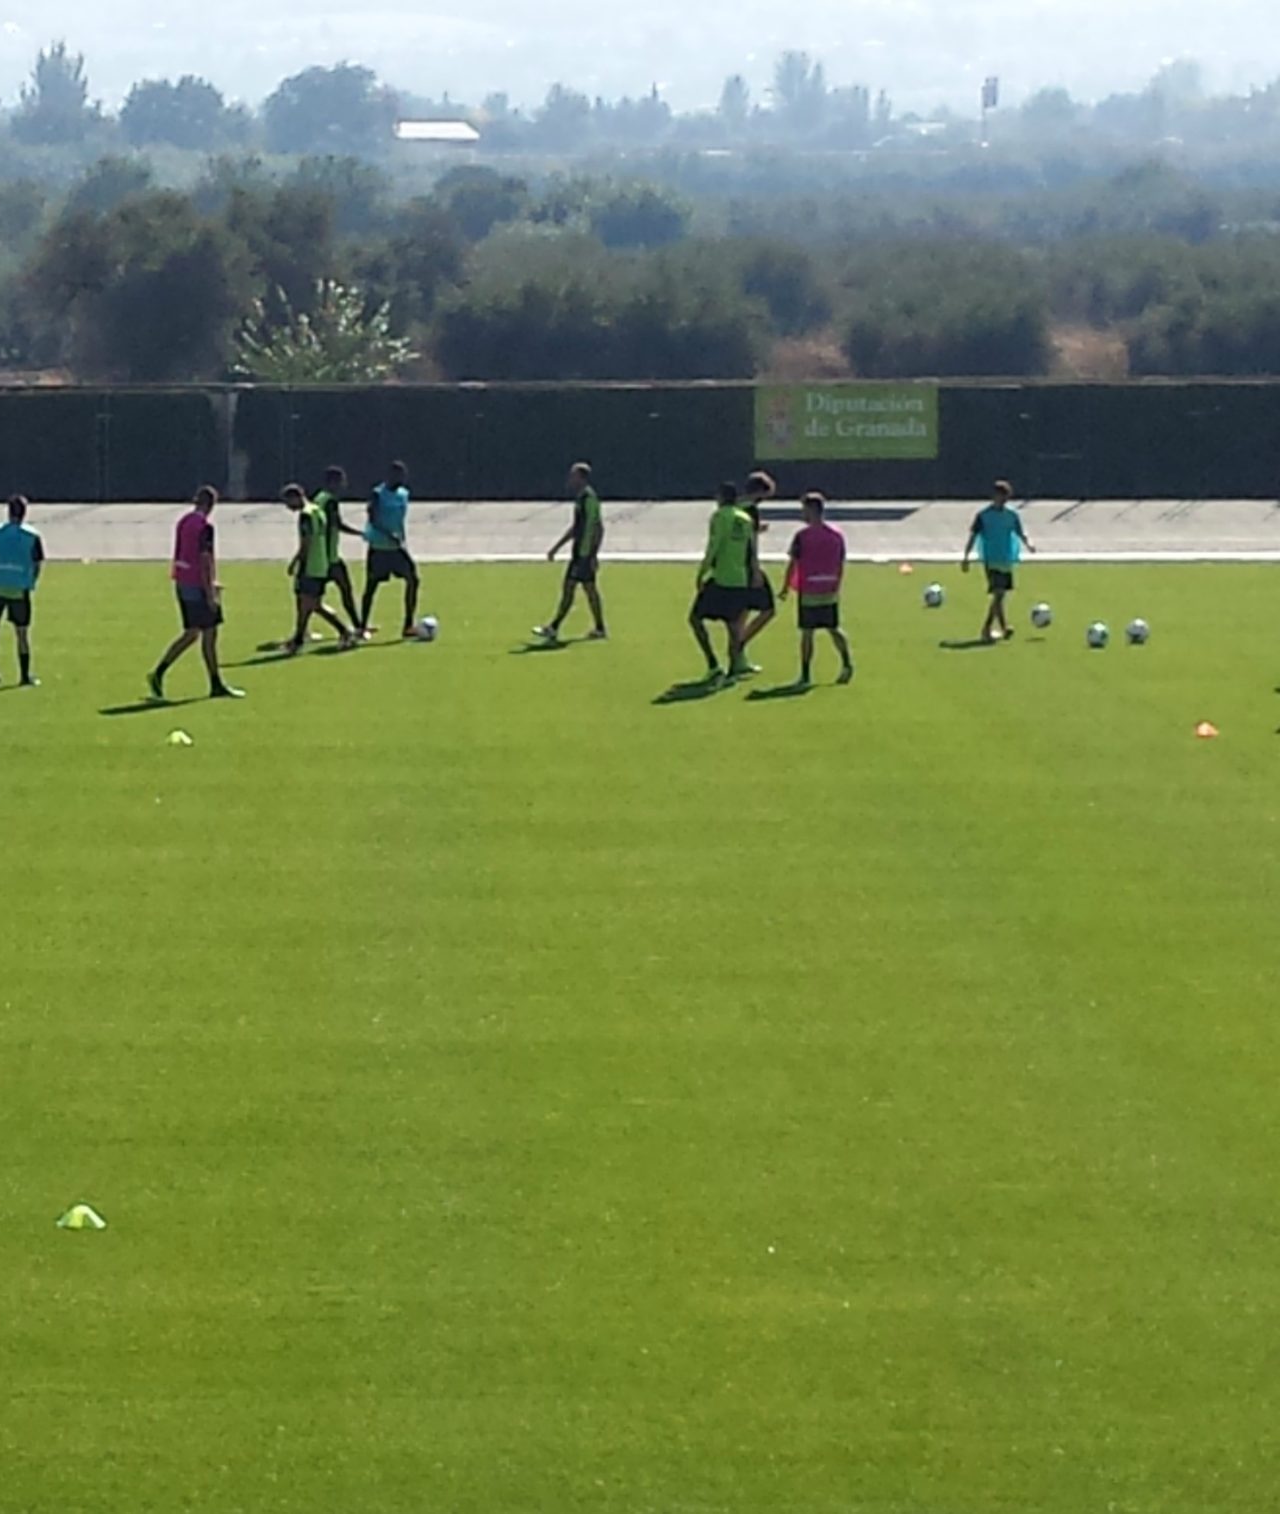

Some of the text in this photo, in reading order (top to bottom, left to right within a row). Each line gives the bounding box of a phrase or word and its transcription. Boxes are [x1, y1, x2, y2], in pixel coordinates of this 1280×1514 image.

[806, 392, 924, 414] Diputación
[804, 417, 927, 437] de Granada
